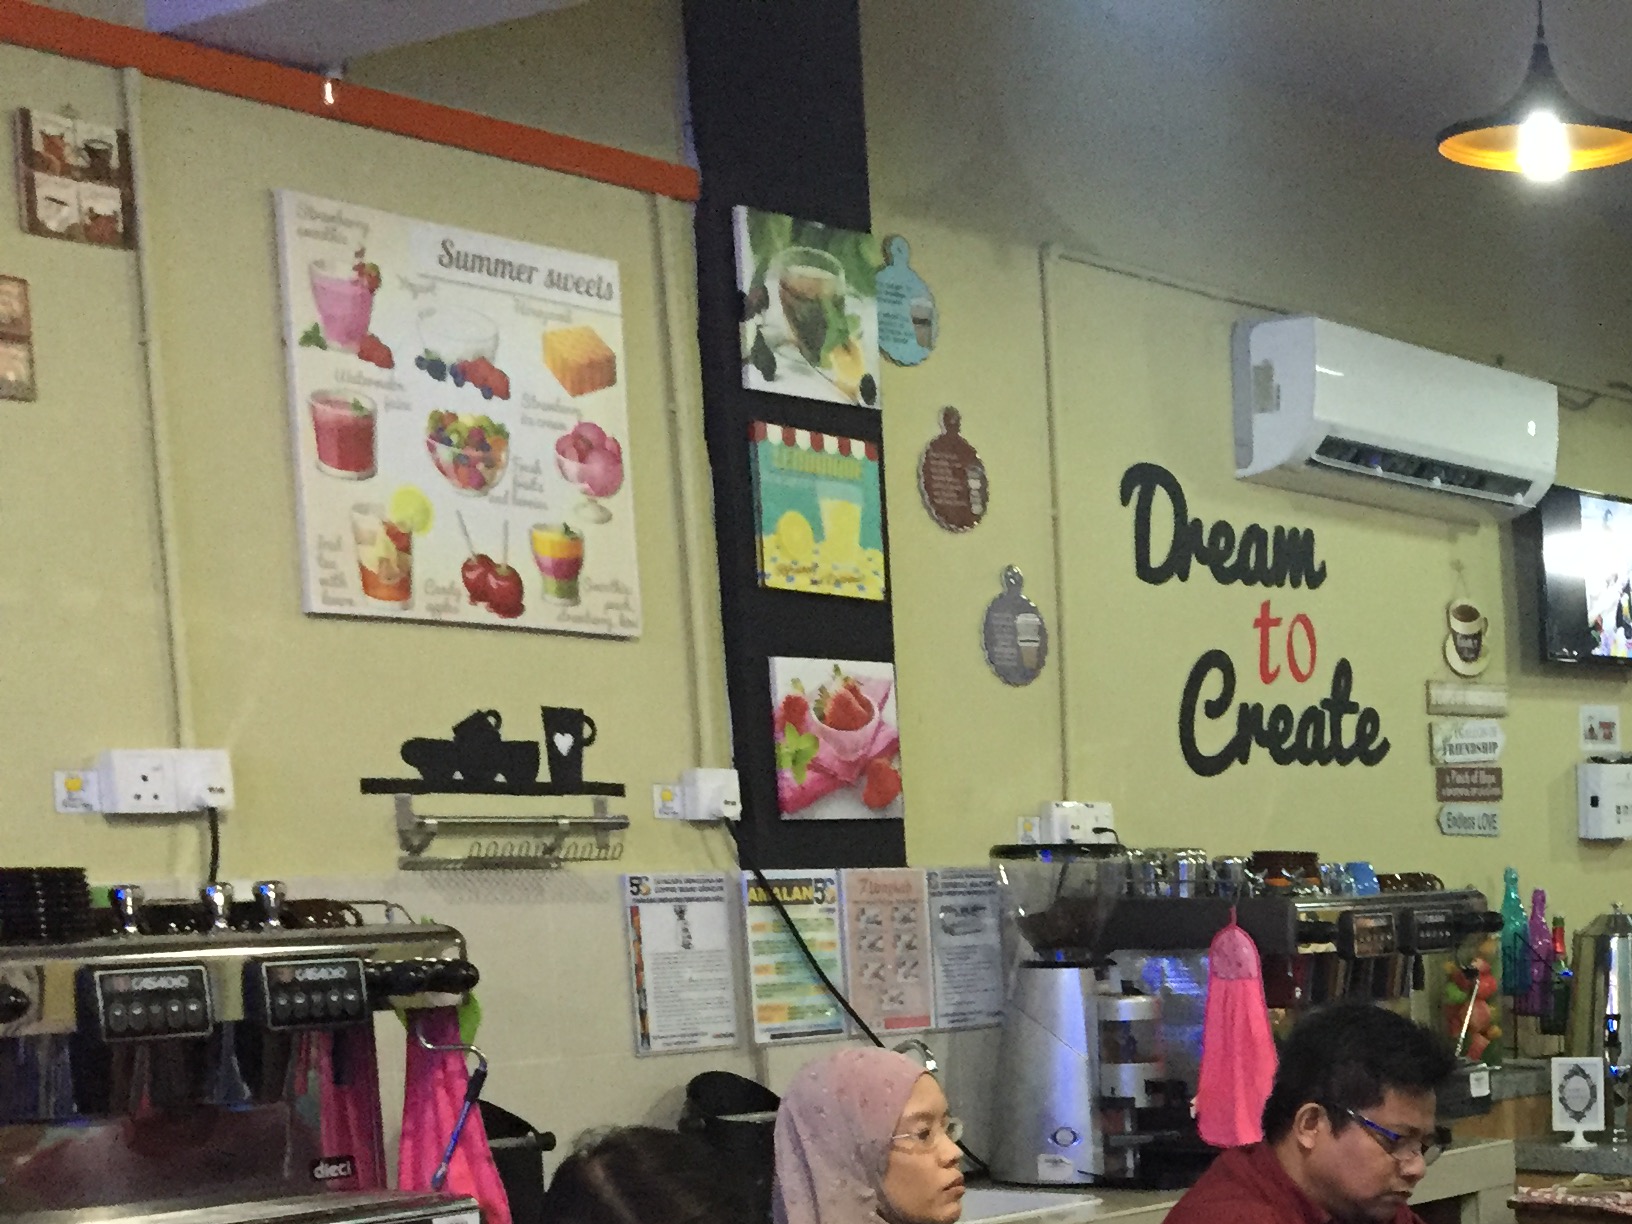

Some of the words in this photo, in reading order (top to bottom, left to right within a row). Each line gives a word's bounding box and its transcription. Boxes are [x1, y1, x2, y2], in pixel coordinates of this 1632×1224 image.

[437, 238, 539, 285] Summer
[543, 268, 614, 301] sweets
[1119, 461, 1328, 591] Dream
[1252, 599, 1317, 685] to
[1178, 648, 1391, 777] Create
[1477, 812, 1498, 831] LOVE
[313, 1159, 351, 1180] dieci
